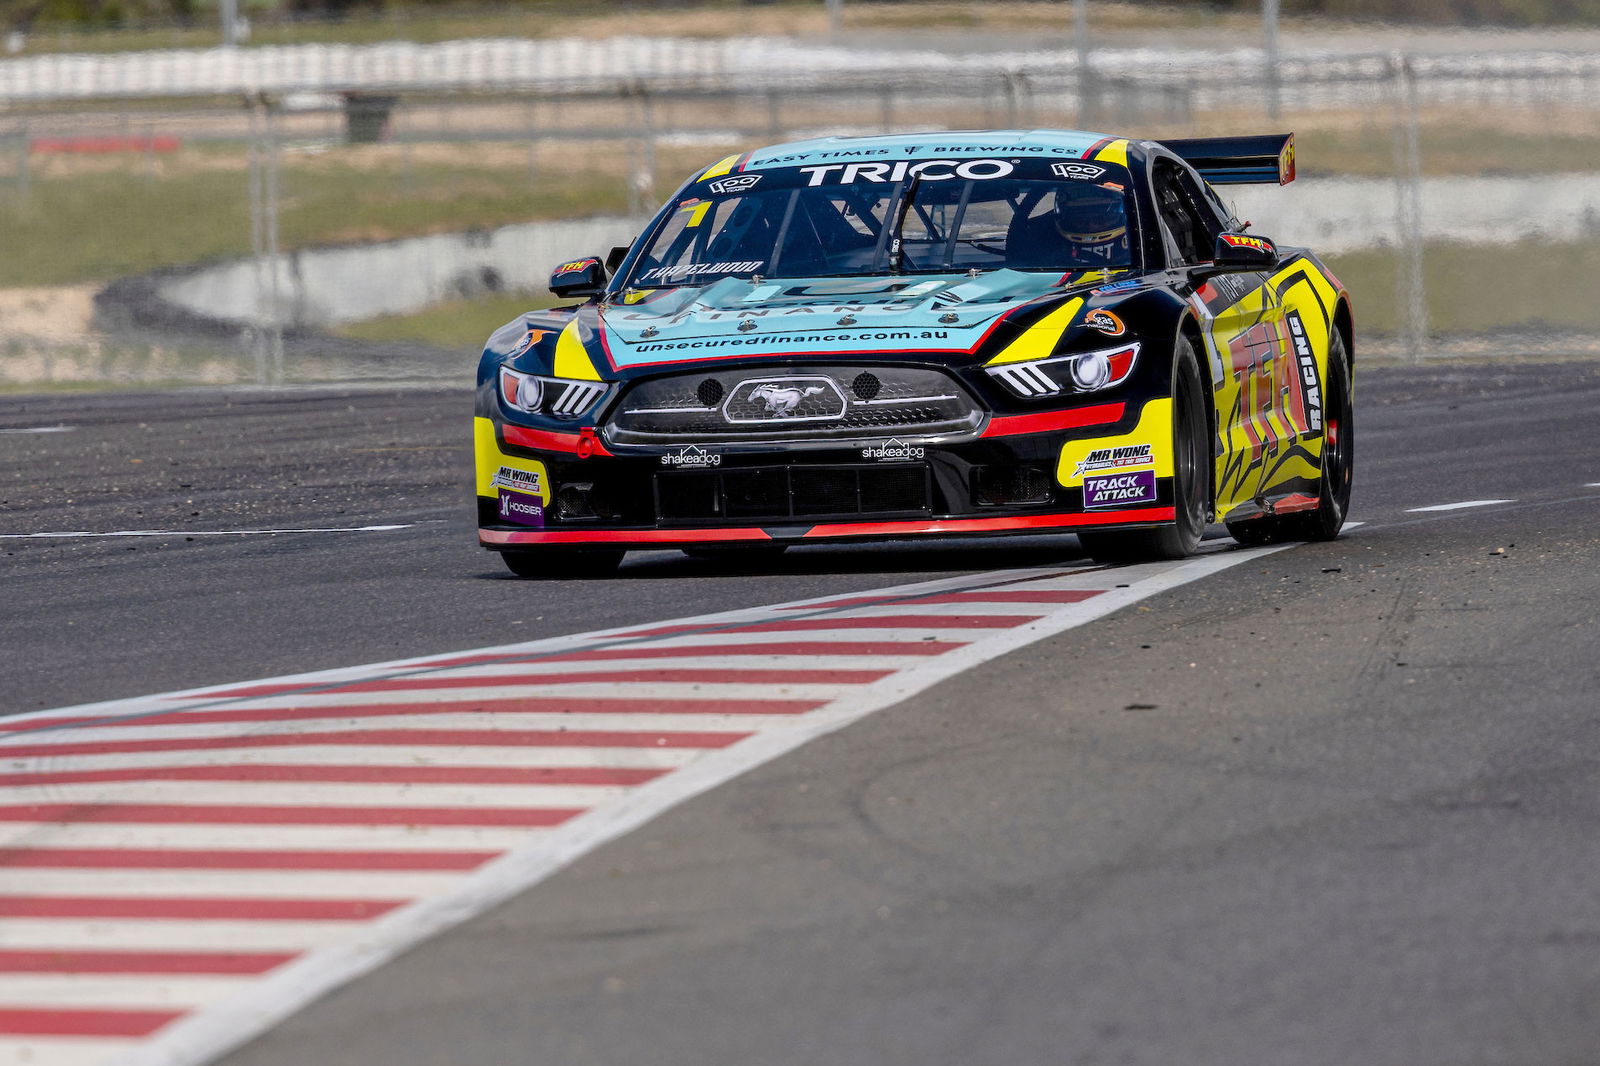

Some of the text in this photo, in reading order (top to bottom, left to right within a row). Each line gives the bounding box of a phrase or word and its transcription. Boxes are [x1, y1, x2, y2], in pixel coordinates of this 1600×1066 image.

[753, 153, 812, 165] EASY
[819, 148, 889, 158] TIMES
[800, 159, 1014, 187] TRICO
[1230, 236, 1261, 247] TFH
[561, 261, 585, 272] TFH
[635, 330, 948, 353] unsecuredfinance.com.au
[1289, 316, 1322, 431] RACING
[661, 448, 721, 466] shakeadog
[862, 441, 925, 459] shakeadog
[1089, 449, 1112, 462] MR
[1112, 444, 1151, 460] WONG
[500, 466, 512, 479] MR
[512, 470, 539, 484] WONG
[1087, 475, 1139, 492] TRACK
[1092, 486, 1146, 502] ATTACK
[510, 501, 542, 516] HOOSIER
